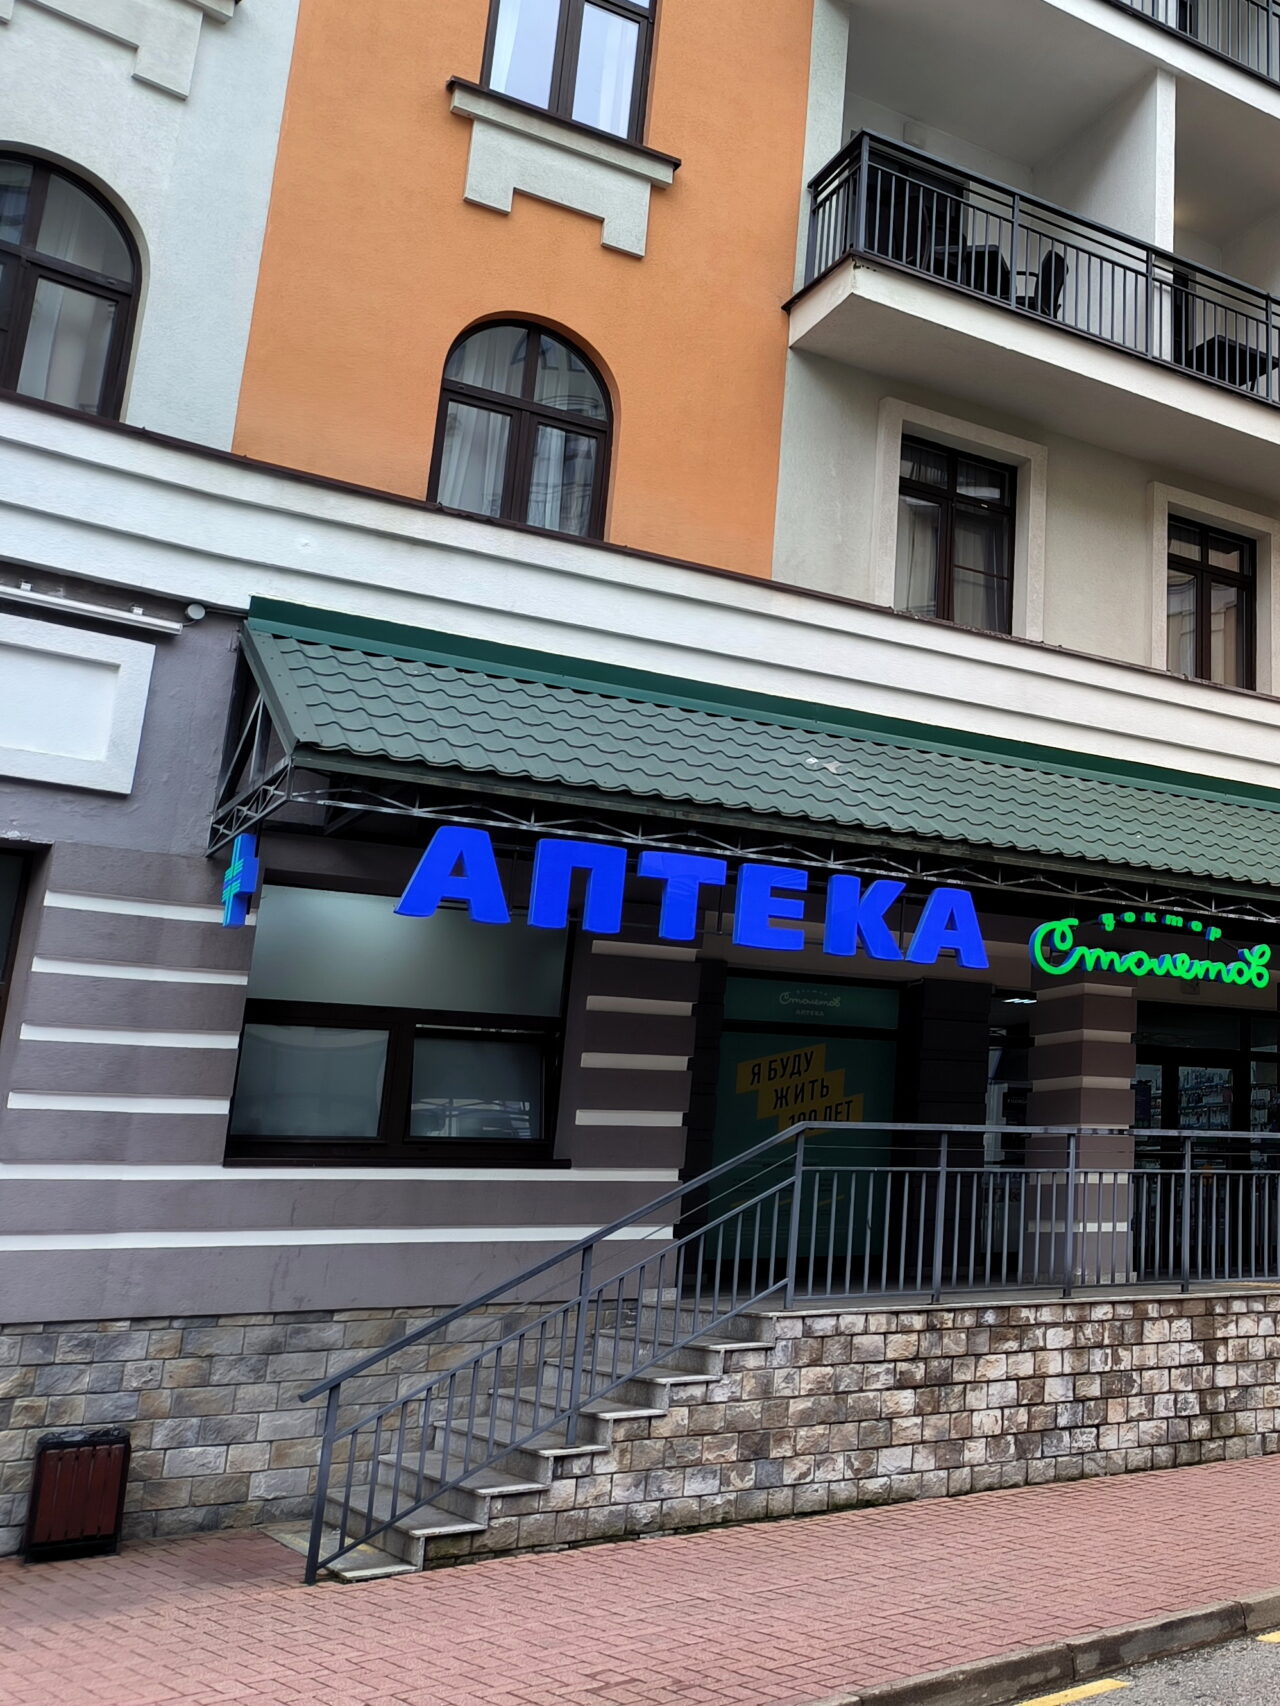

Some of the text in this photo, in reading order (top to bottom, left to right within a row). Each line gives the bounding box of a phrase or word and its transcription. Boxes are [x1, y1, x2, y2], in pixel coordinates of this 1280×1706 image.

[394, 825, 989, 969] АПТЕКА
[1028, 917, 1271, 988] Столетов
[750, 1050, 814, 1085] Я БУДУ
[773, 1077, 830, 1110] ЖИТЬ
[824, 1099, 853, 1121] ЛЕТ
